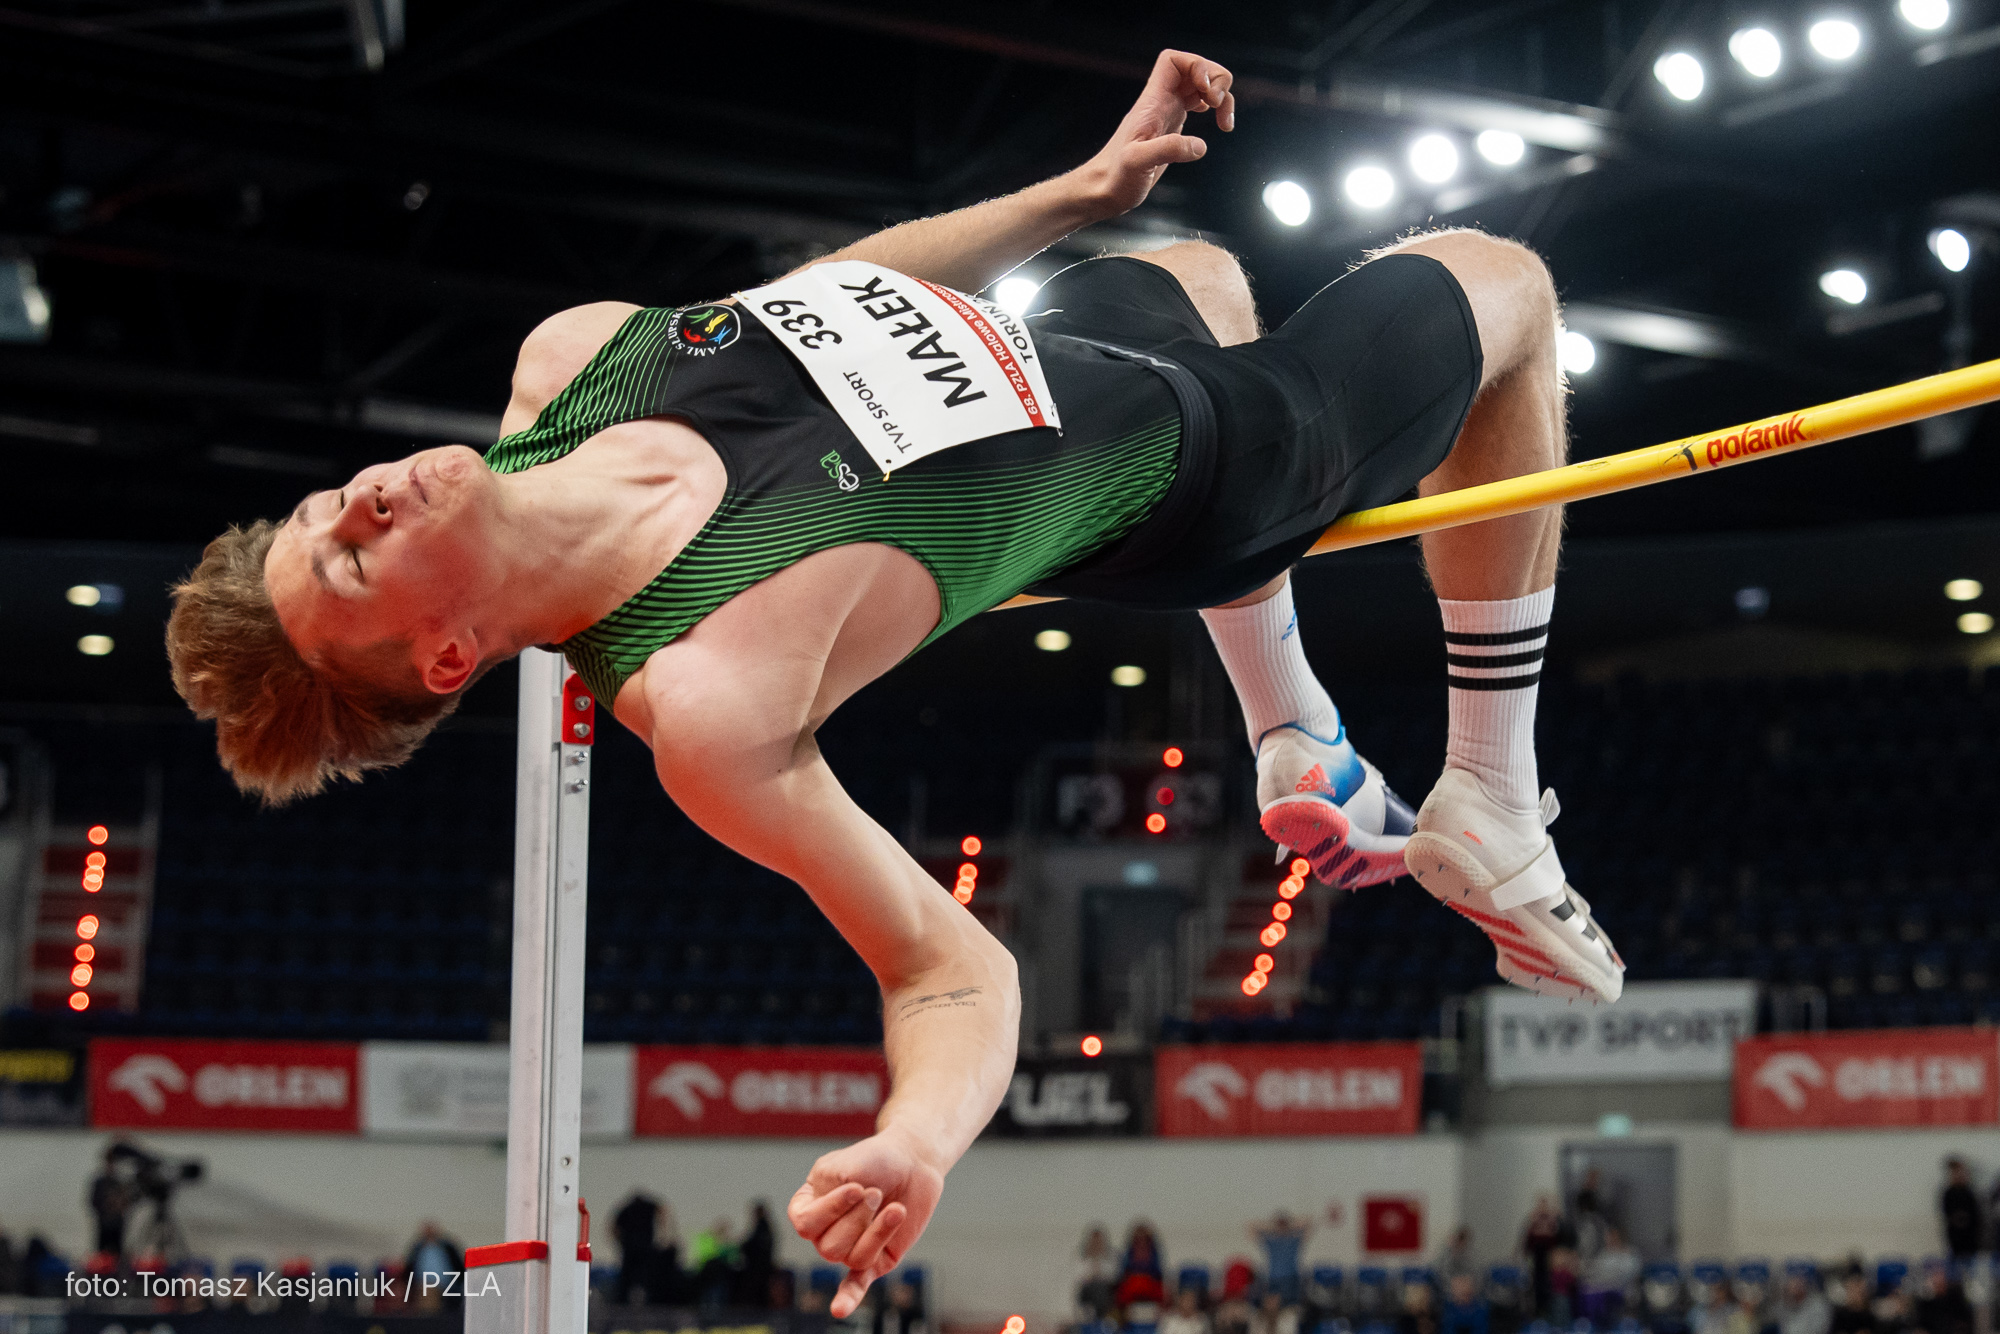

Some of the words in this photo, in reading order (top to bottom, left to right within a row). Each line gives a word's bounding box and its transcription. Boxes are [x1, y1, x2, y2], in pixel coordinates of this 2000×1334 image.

[762, 300, 843, 350] 339
[838, 276, 988, 409] MAŁEK
[975, 320, 1010, 361] Halowe
[686, 346, 717, 357] AML
[842, 371, 889, 420] SPORT
[1005, 361, 1028, 393] PZLA
[1023, 394, 1038, 415] 68.
[882, 421, 913, 454] TVP
[1705, 412, 1809, 468] polanik
[1295, 780, 1336, 798] adidas
[1501, 1011, 1591, 1053] TVP
[195, 1063, 348, 1109] ORLEN
[731, 1070, 881, 1114] ORLEN
[1255, 1067, 1401, 1112] ORLEN
[1836, 1057, 1986, 1101] ORLEN
